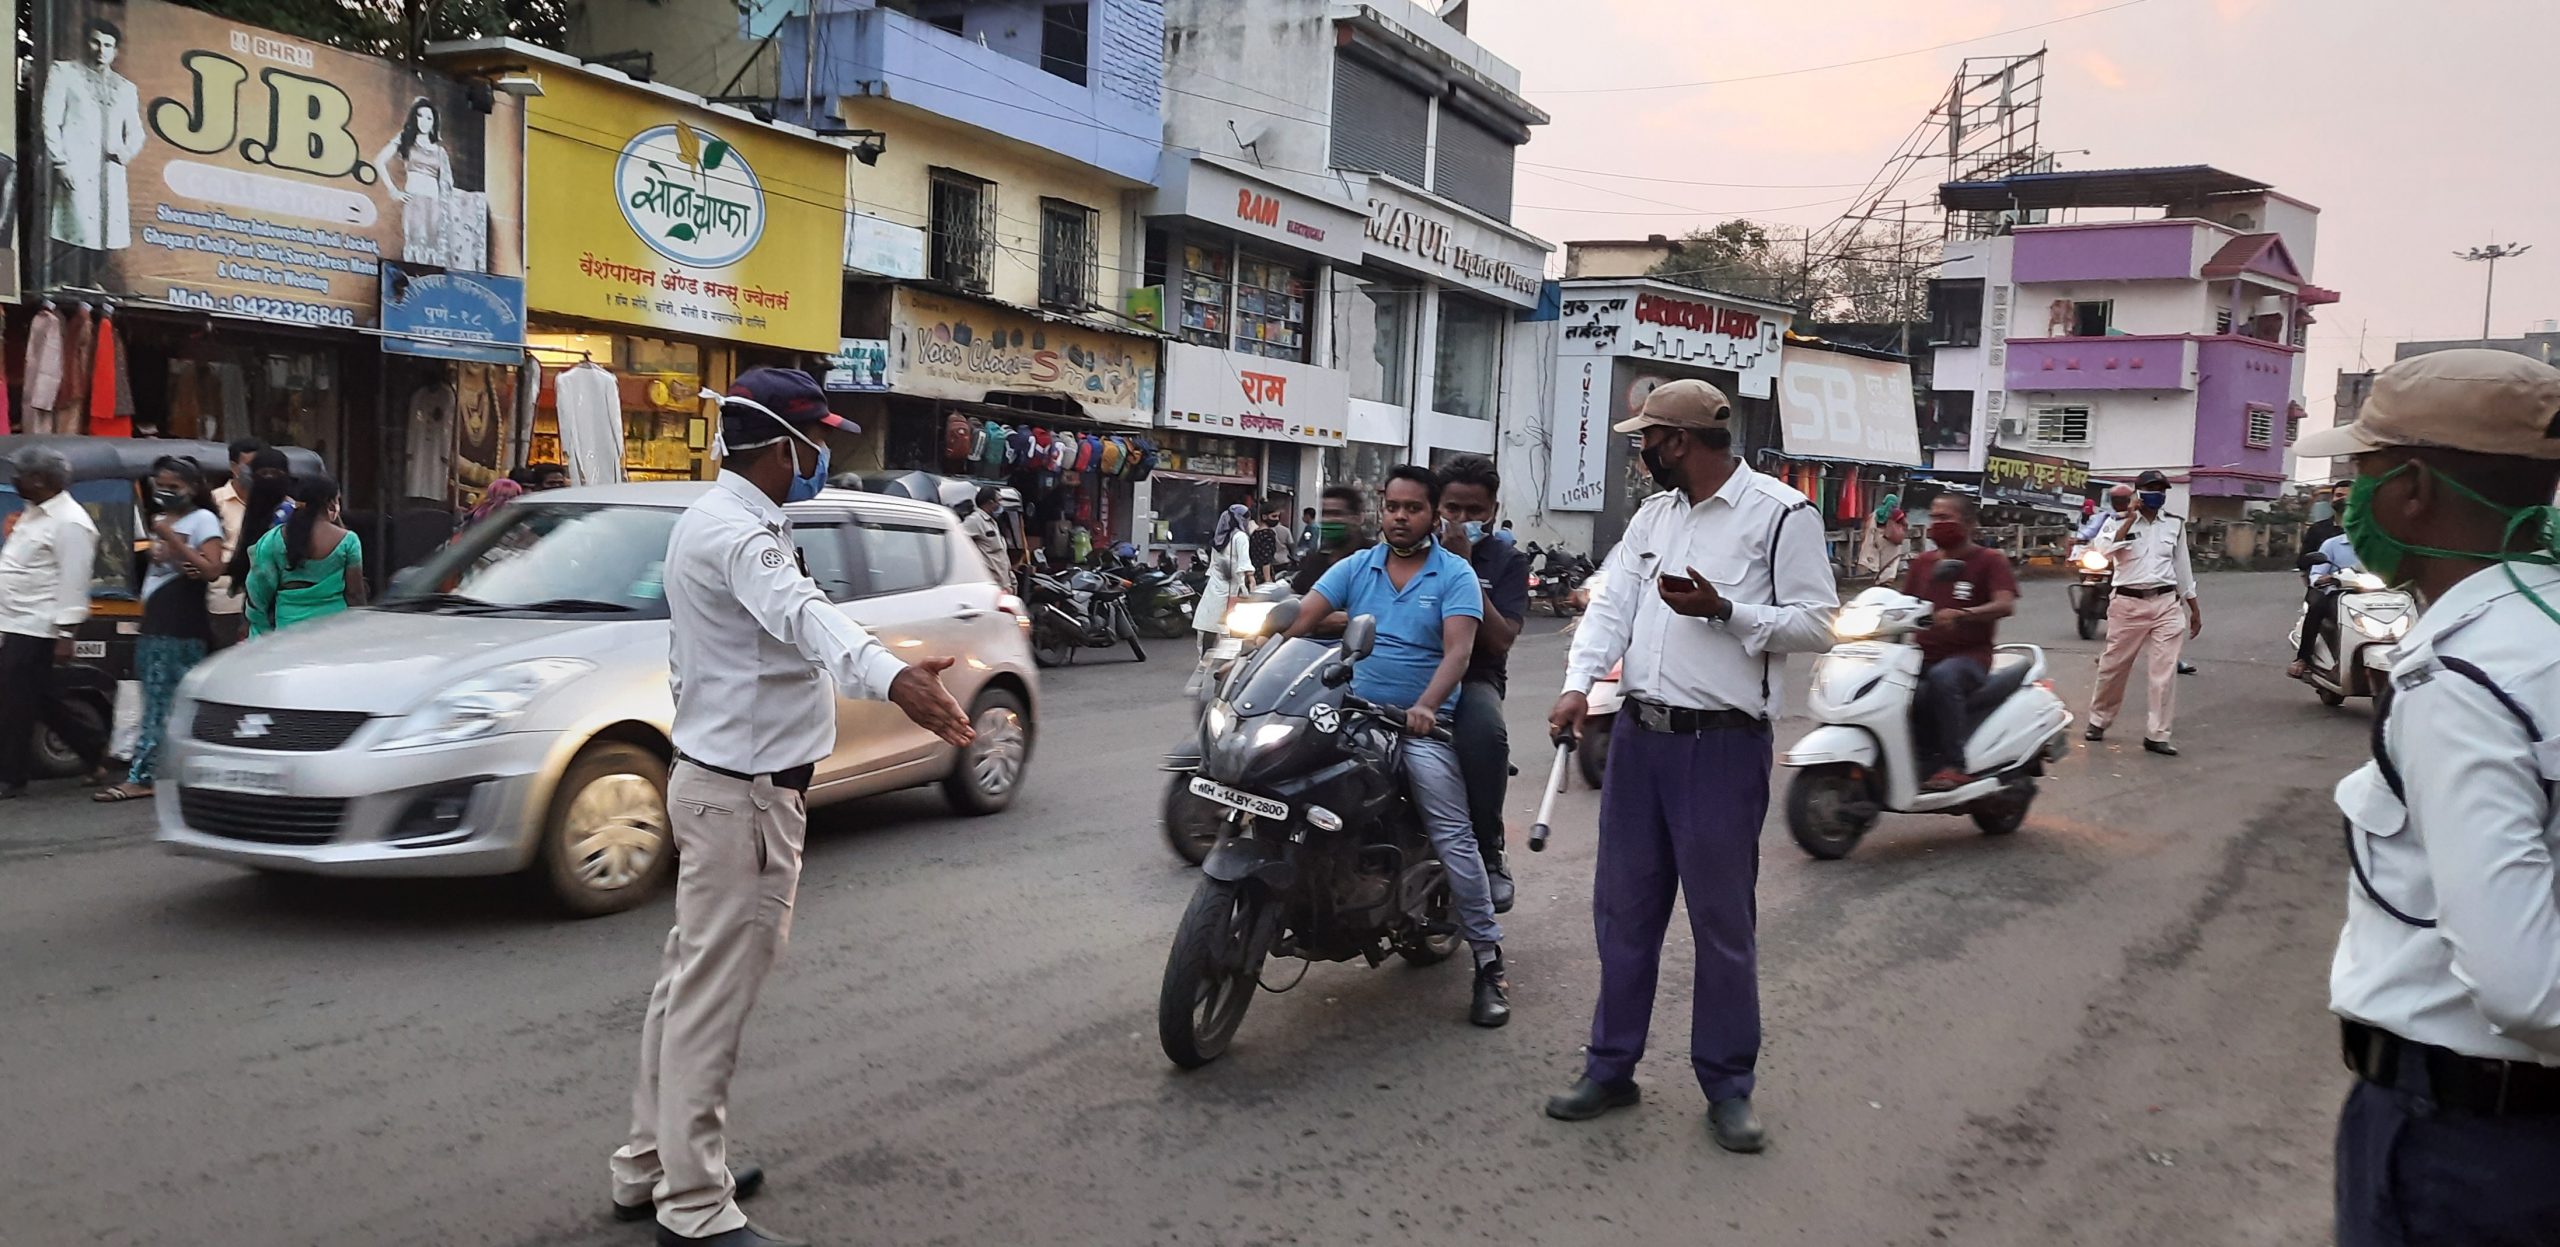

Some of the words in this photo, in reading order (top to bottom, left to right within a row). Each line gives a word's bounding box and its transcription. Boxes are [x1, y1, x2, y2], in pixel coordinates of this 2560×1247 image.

[147, 49, 378, 185] J.B.
[1237, 188, 1280, 228] RAM
[1365, 198, 1454, 266] MAYUR
[1505, 264, 1538, 296] Decor
[229, 264, 260, 283] Order
[263, 267, 282, 284] For
[284, 269, 330, 293] Wedding
[579, 251, 656, 288] वैशंपायन
[743, 285, 790, 311] ज्वेलर्स
[231, 294, 354, 326] 9422326846
[917, 326, 963, 366] Your
[1241, 370, 1286, 407] राम
[1783, 361, 1861, 444] SB
[1577, 362, 1592, 486] GURUKRIPA
[1562, 481, 1603, 506] LIGHTS
